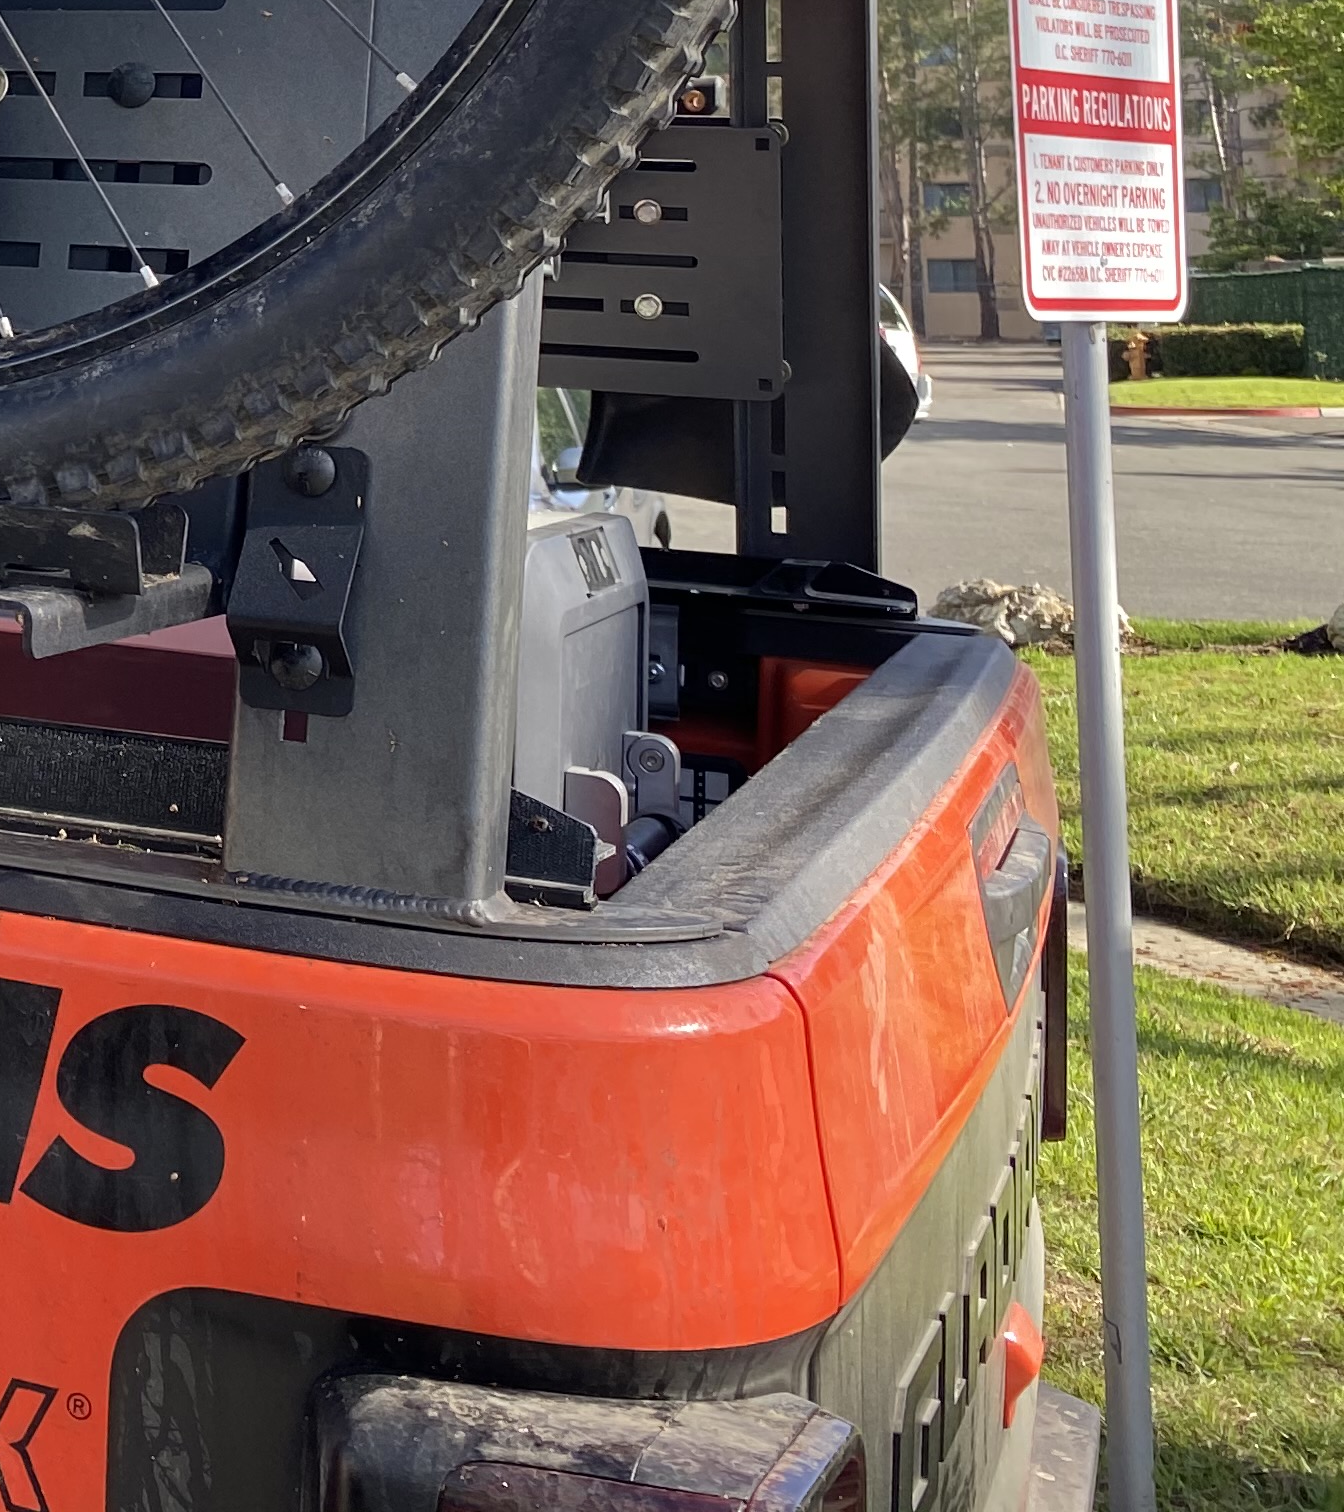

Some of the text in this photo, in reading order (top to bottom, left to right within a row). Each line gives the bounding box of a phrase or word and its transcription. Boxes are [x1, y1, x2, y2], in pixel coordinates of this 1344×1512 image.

[1107, 0, 1156, 21] TRESPASSING
[1035, 16, 1151, 45] VIOLATORS WILL BE PROSECUTED
[1070, 45, 1100, 64] SHERIFF
[1021, 83, 1172, 133] PARKING REGULATIONS
[1040, 153, 1066, 172] TENANT
[1067, 154, 1073, 172] &
[1073, 155, 1115, 176] CUSTOMERS
[1115, 159, 1146, 177] PARKING
[1146, 161, 1165, 178] ONLY
[1034, 179, 1166, 210] 2. NO OVERNIGHT PARKING
[1032, 212, 1171, 234] UNAUTHORIZED VEHICLES WILL BE TOWED
[1042, 239, 1164, 258] AWAY AT VEHICLE OWNER'S EXPENSE
[1042, 265, 1057, 281] CVC
[1104, 267, 1133, 283] SHERIFF
